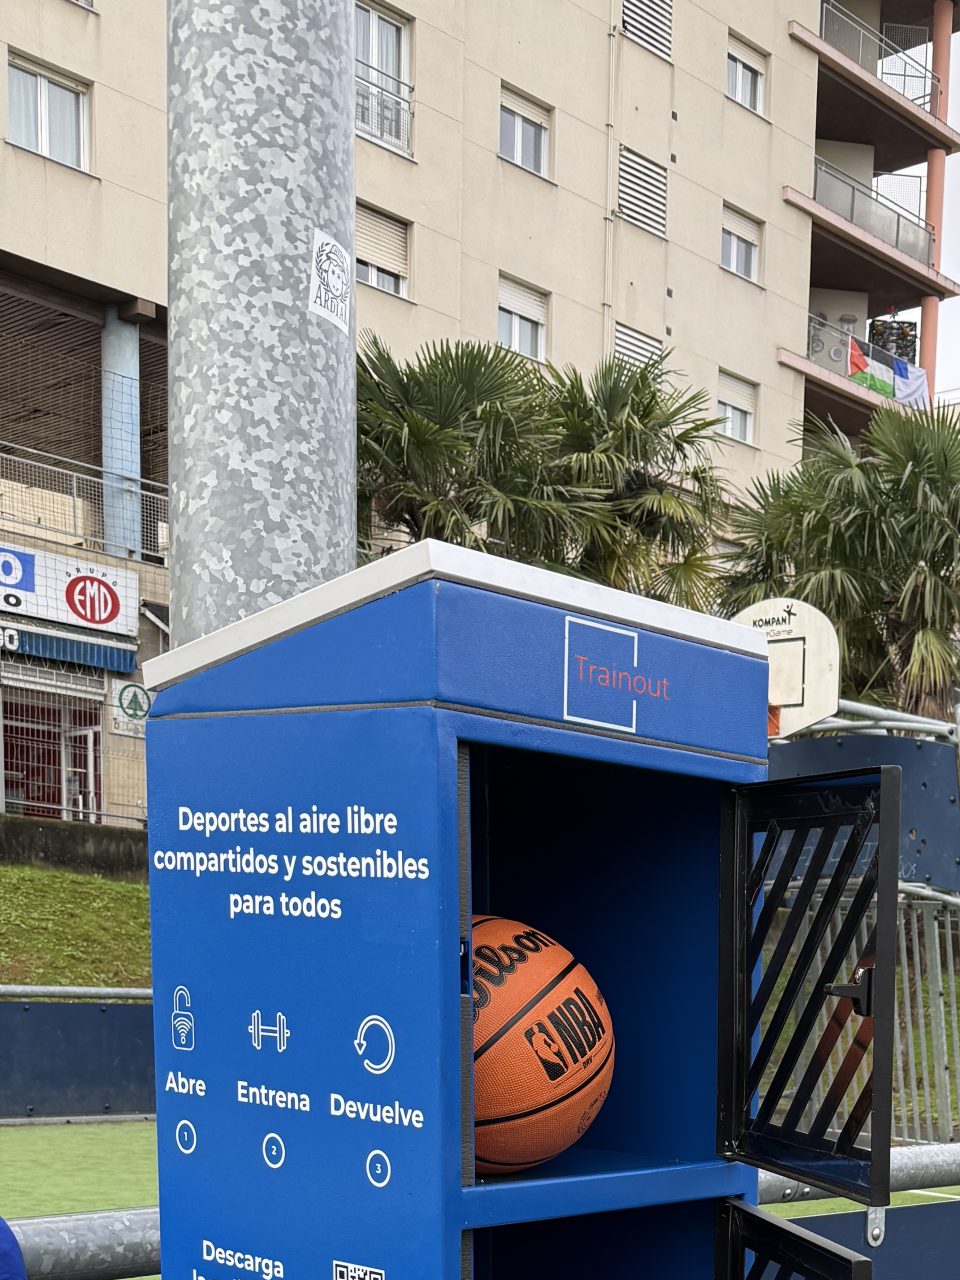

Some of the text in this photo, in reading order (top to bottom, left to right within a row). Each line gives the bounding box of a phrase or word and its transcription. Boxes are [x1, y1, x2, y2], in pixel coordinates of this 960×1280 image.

[65, 567, 118, 587] GRUPO
[575, 655, 671, 702] Trainout
[178, 804, 398, 838] Deportes al aire libre
[153, 846, 430, 882] compartidos y sostenibles
[229, 890, 342, 919] para todos
[546, 986, 606, 1065] NBA
[165, 1071, 424, 1129] Abre Entrena Devuelve
[202, 1239, 284, 1280] Descarga
